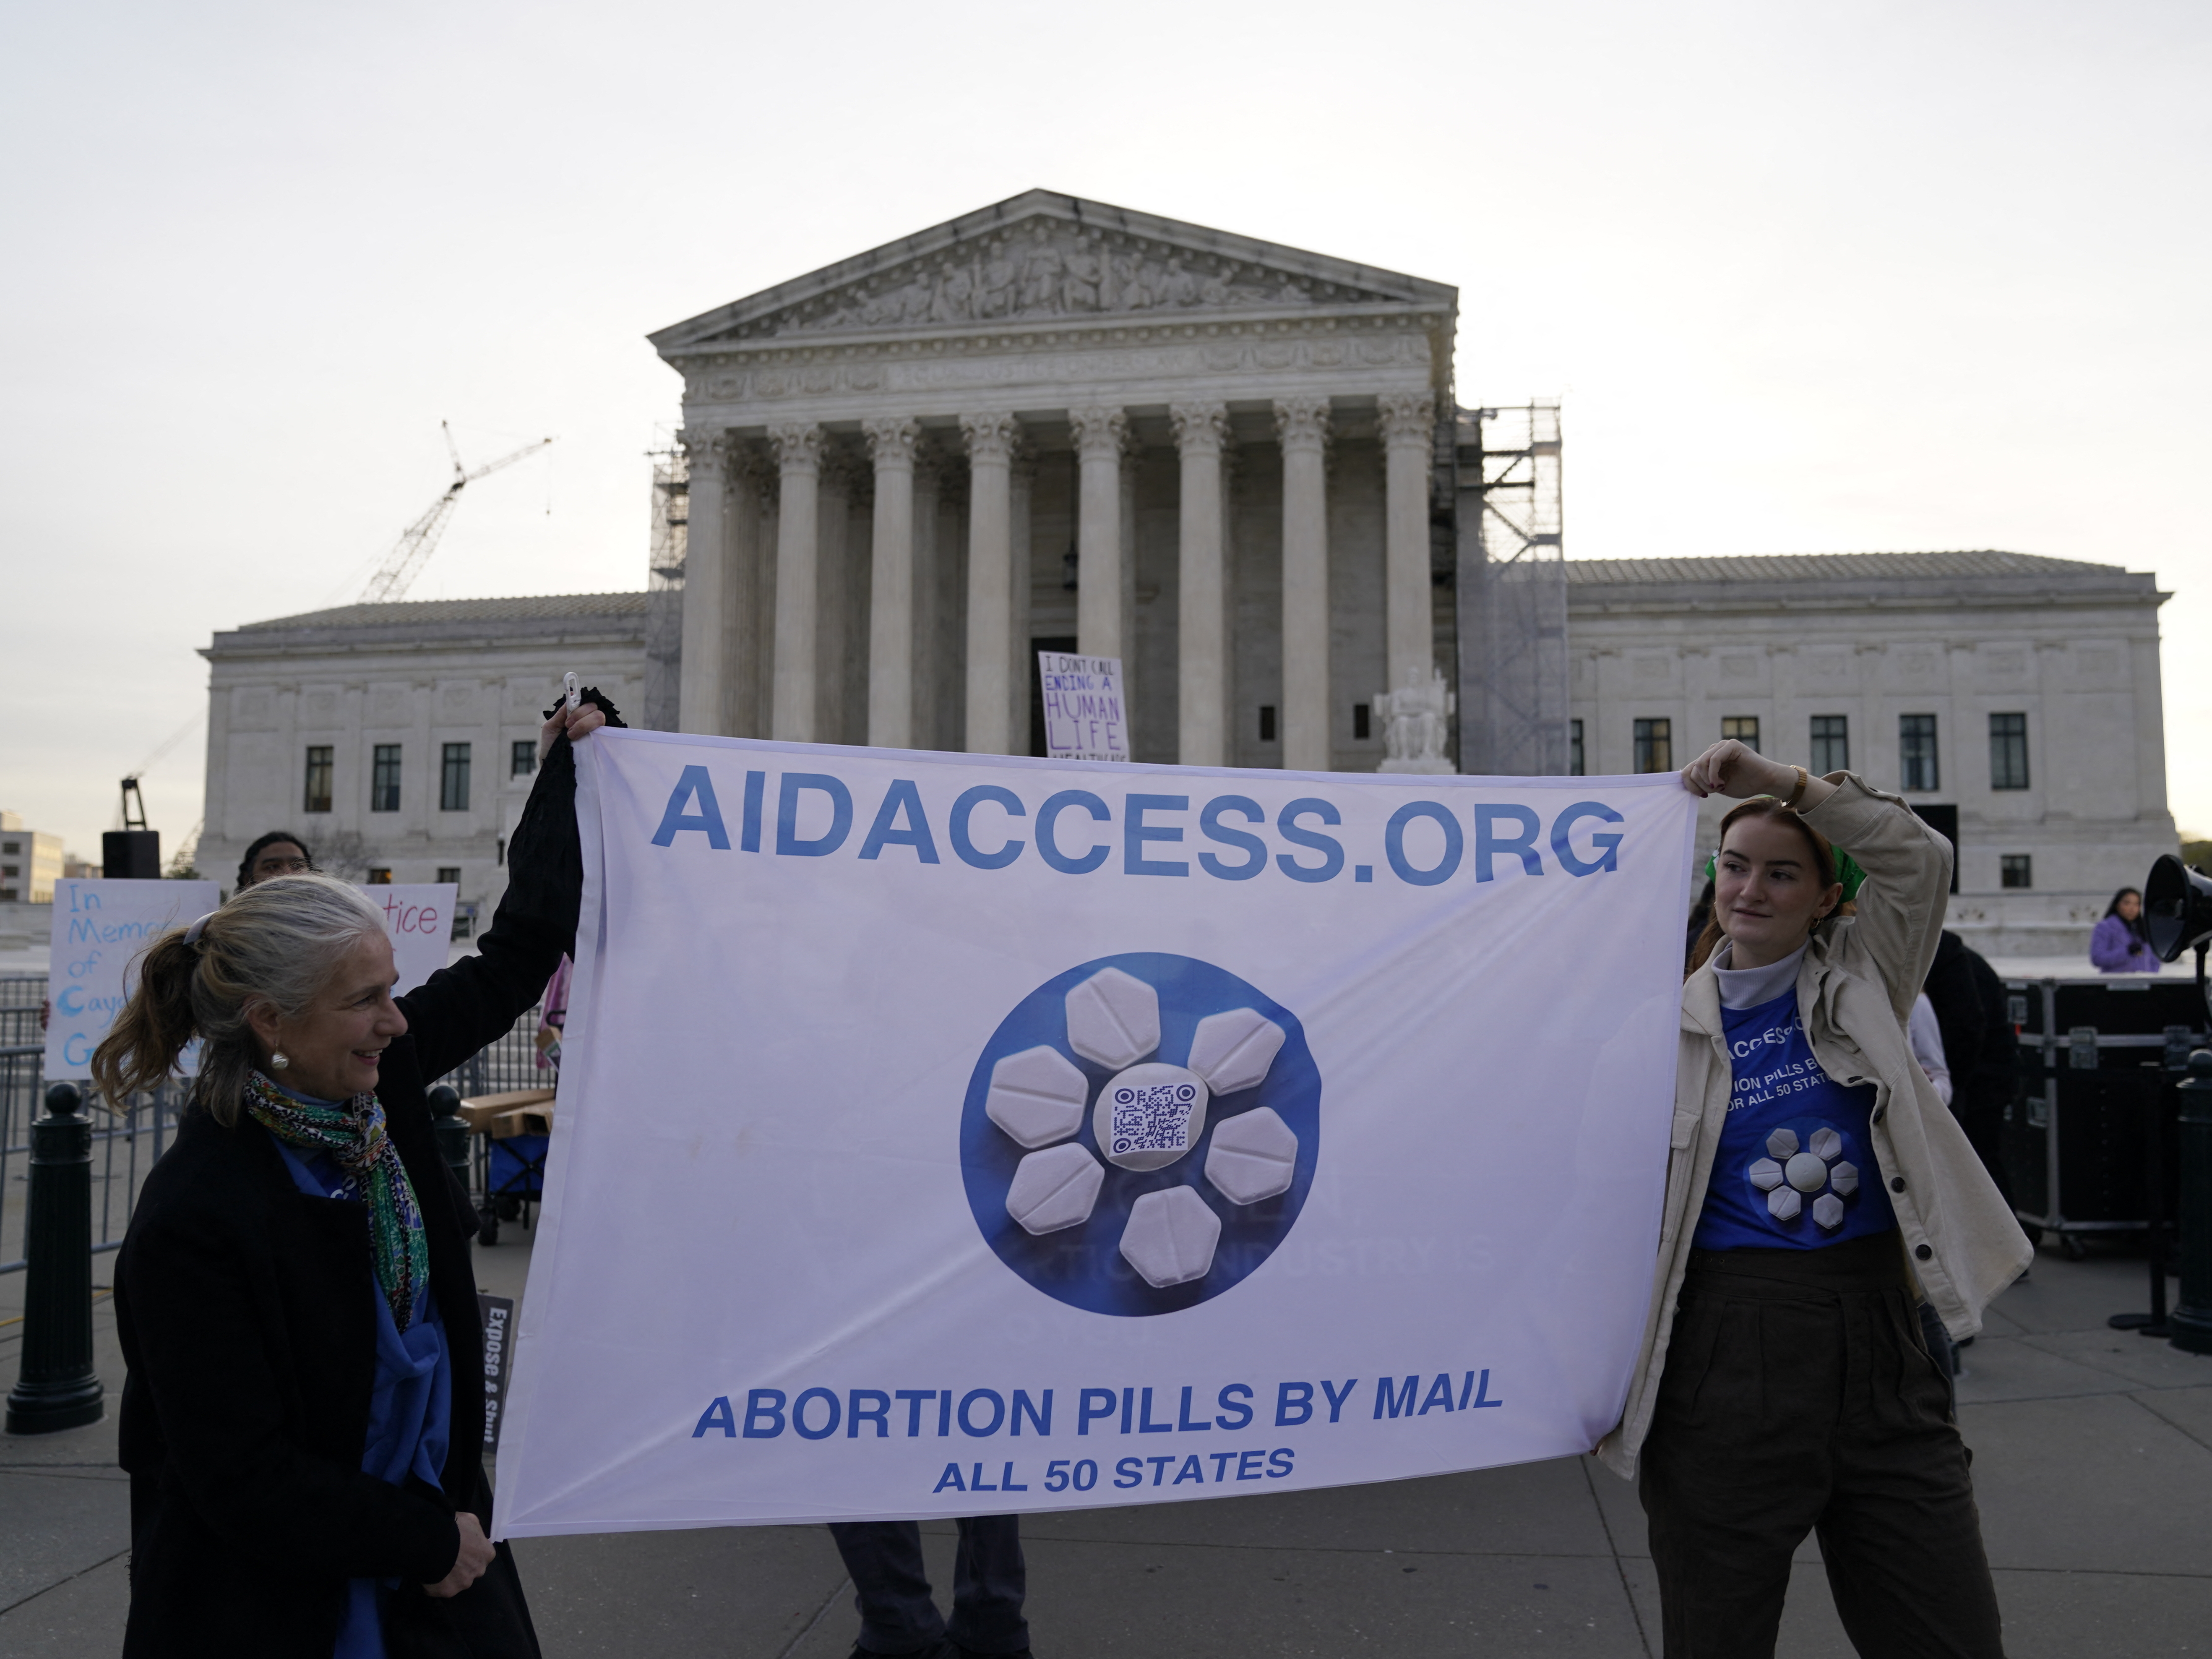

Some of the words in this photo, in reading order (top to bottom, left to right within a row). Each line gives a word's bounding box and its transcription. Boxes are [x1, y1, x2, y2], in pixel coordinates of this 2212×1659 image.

[1045, 656, 1052, 672] I
[1046, 675, 1094, 691] ENDING
[1102, 677, 1111, 691] A
[1047, 692, 1120, 722] HUMAN
[1050, 720, 1121, 751] LIFE
[651, 765, 1624, 886] AIDACCESS.ORG
[69, 884, 101, 913] In
[382, 893, 437, 934] tice
[68, 918, 168, 944] Memo
[68, 950, 102, 978] of
[1734, 1077, 1761, 1092] ION
[1764, 1064, 1804, 1085] PILLS
[1805, 1058, 1818, 1070] B
[1727, 1098, 1744, 1111] OR
[1749, 1090, 1774, 1106] ALL
[1776, 1083, 1791, 1096] 50
[485, 1307, 508, 1377] Expose
[485, 1380, 498, 1393] &
[692, 1387, 1053, 1440] ABORTION
[1078, 1383, 1254, 1435] PILLS
[1274, 1379, 1357, 1427] BY
[1373, 1369, 1503, 1420] MAIL
[484, 1399, 498, 1443] Shut
[932, 1461, 1029, 1493] ALL
[1044, 1459, 1098, 1492] 50
[1113, 1448, 1295, 1489] STATES
